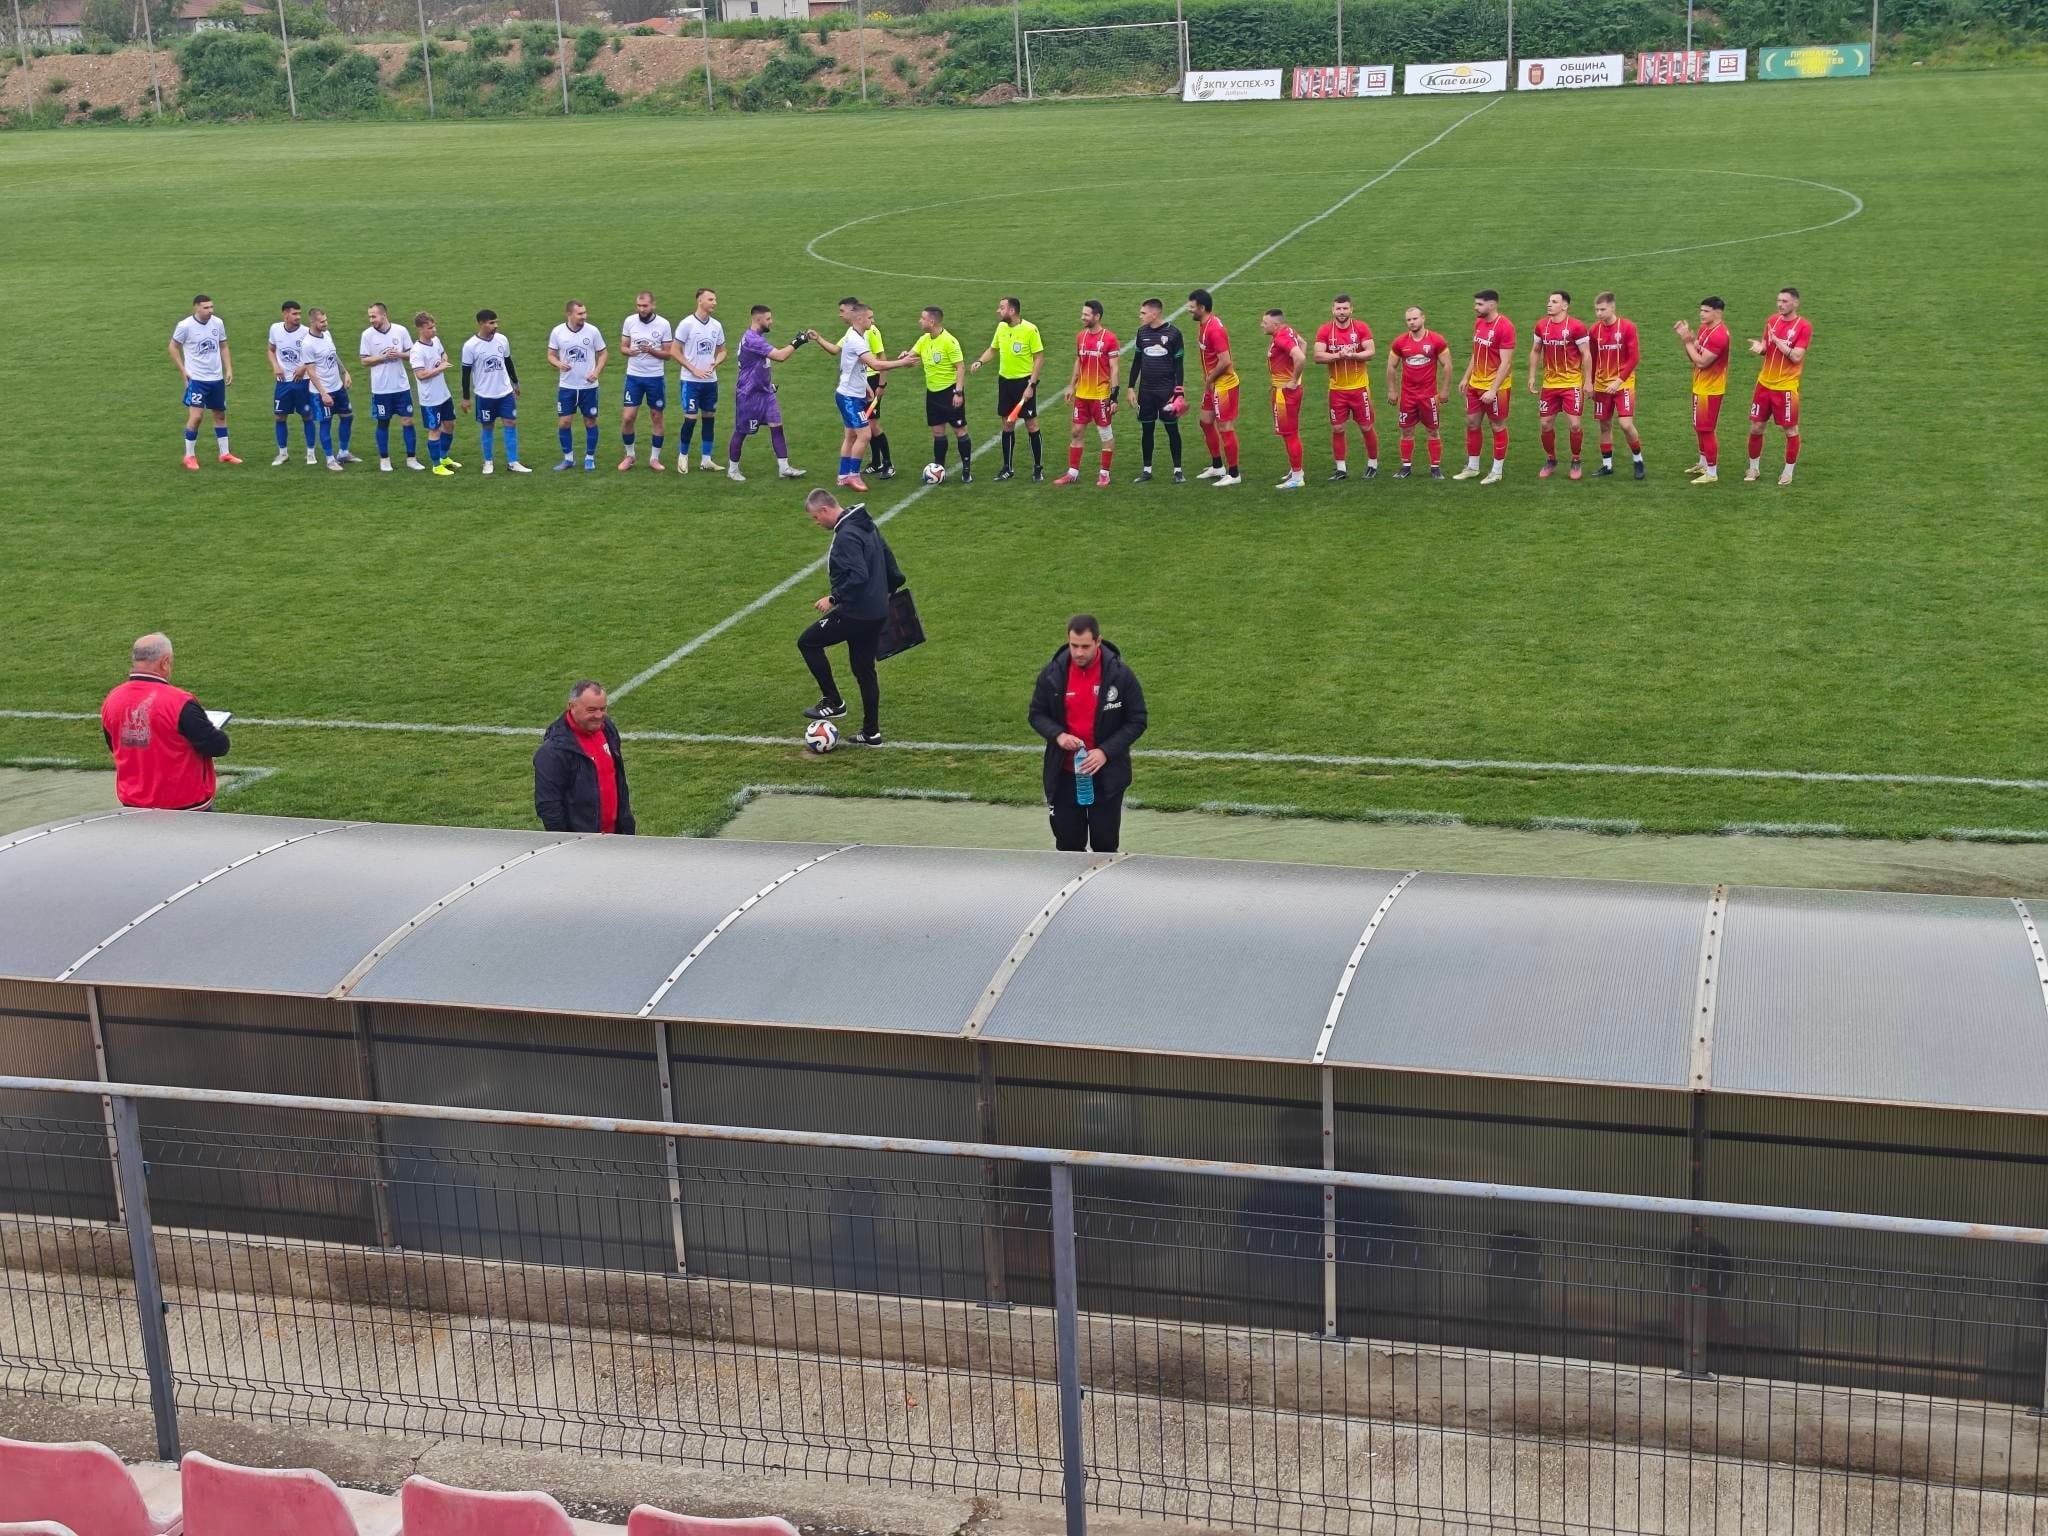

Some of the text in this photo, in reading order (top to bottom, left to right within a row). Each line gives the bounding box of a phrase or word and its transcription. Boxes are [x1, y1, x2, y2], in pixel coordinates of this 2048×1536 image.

[1560, 62, 1606, 72] ОБЩИНА
[1204, 79, 1275, 89] ЗКПУ УСПЕХ-93
[1556, 73, 1609, 86] ДОБРИЧ
[191, 393, 203, 404] 22
[625, 391, 631, 401] 4
[275, 400, 281, 410] 7
[689, 399, 696, 410] 5
[1596, 402, 1603, 413] 11
[377, 405, 386, 415] 18
[482, 410, 491, 420] 15
[1750, 404, 1760, 416] 21
[750, 420, 758, 430] 12
